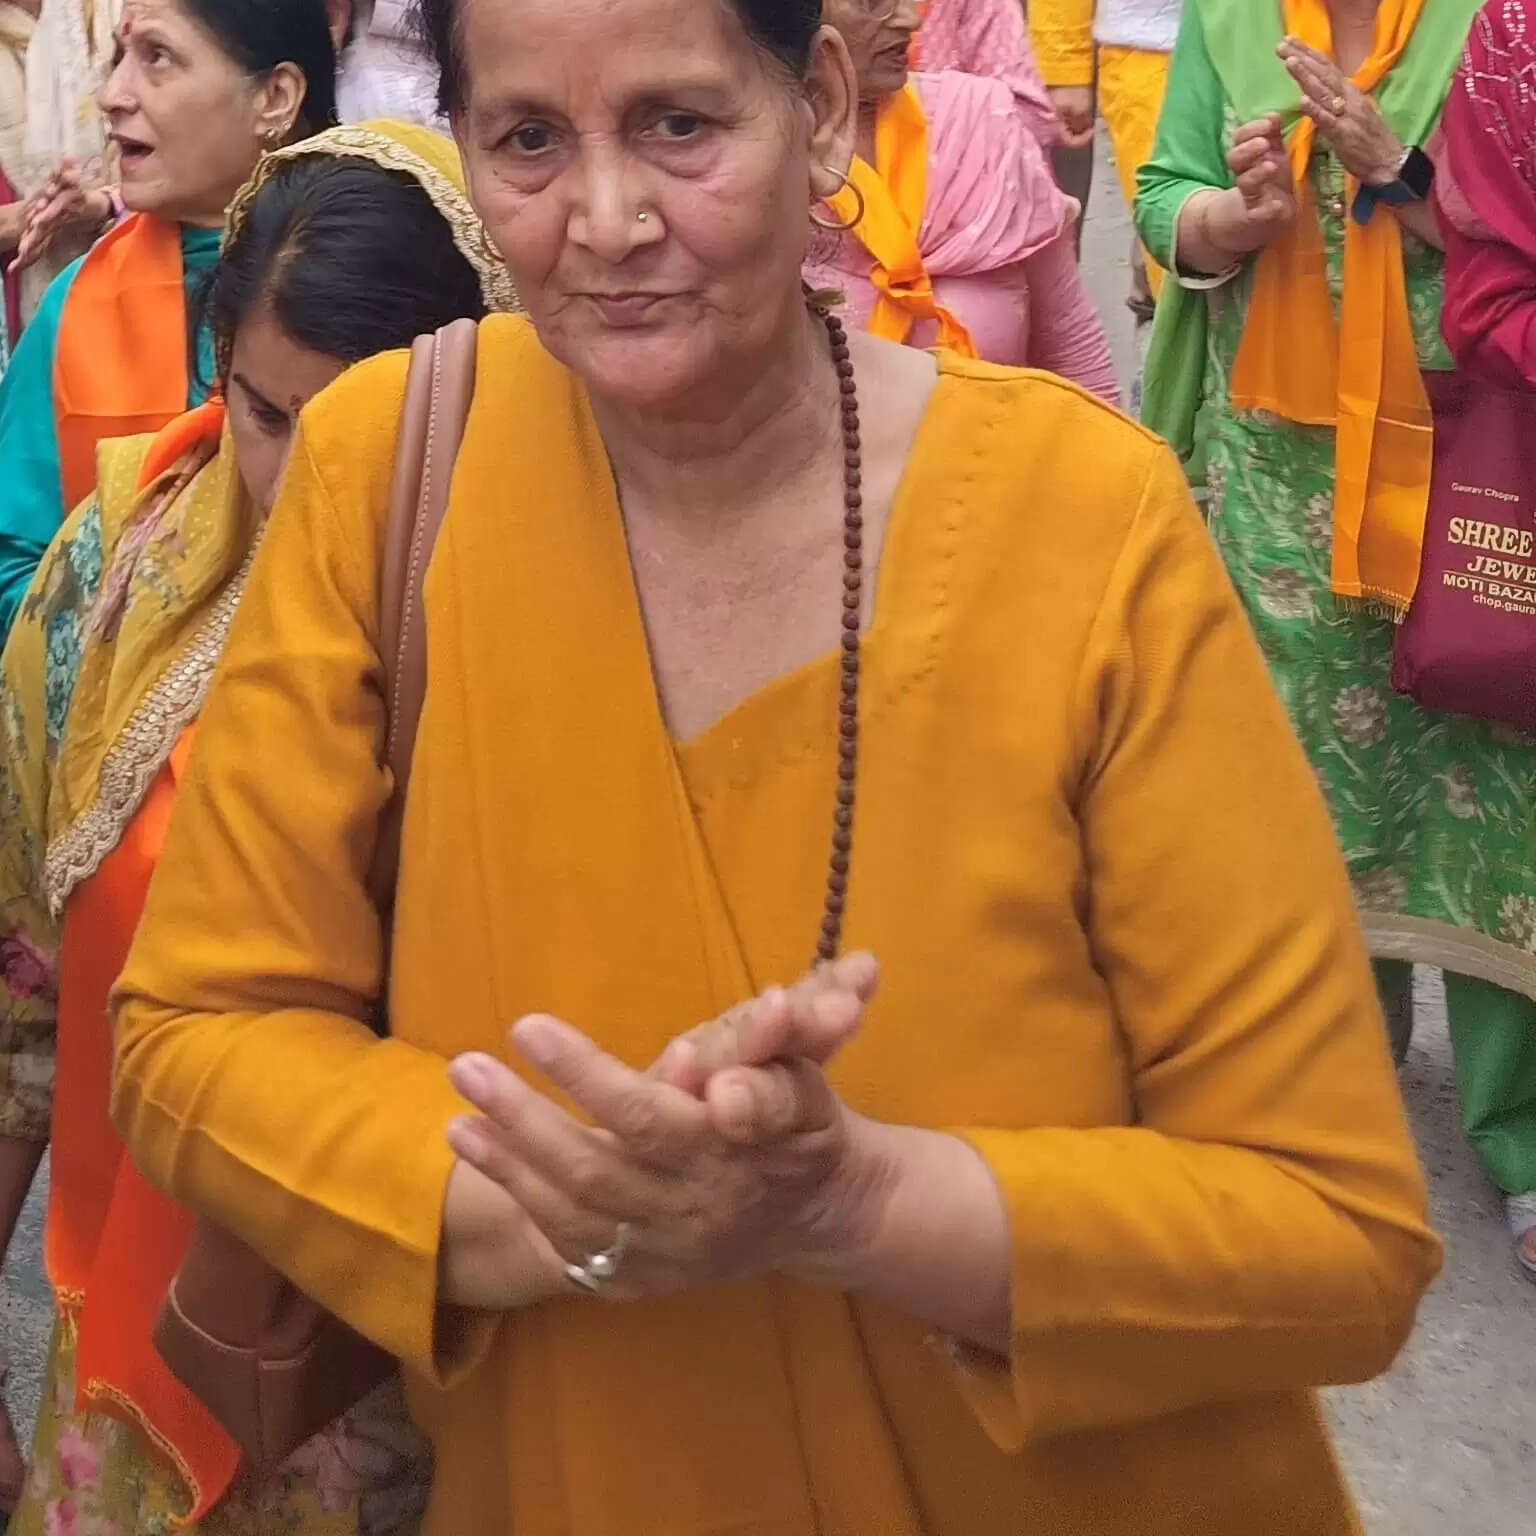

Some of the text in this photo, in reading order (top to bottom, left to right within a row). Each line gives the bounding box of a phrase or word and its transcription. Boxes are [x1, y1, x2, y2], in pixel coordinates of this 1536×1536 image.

[1451, 482, 1520, 502] Gaurav Chopra
[1447, 516, 1533, 558] SHREE
[1443, 573, 1536, 603] MOTI BAZA
